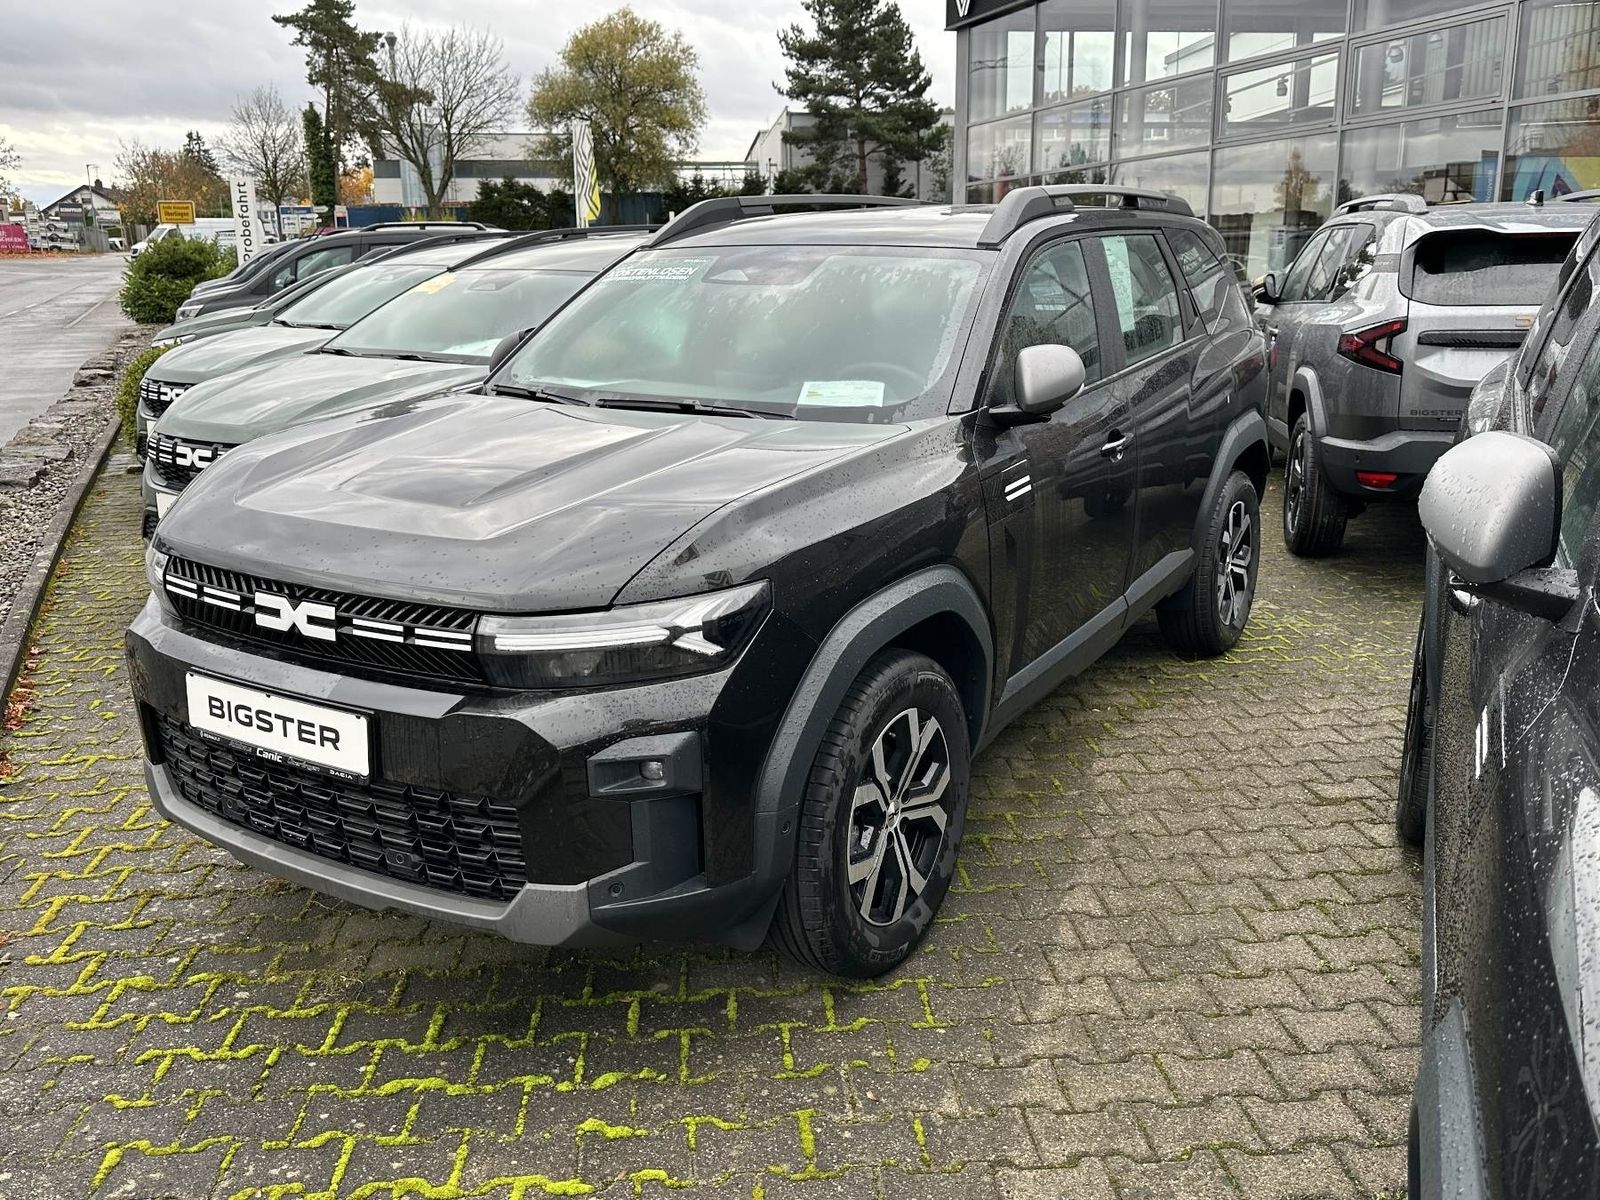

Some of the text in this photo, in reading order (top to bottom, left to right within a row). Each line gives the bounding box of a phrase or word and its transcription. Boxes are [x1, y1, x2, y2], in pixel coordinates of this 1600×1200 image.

[1410, 409, 1463, 417] BIGSTER
[207, 694, 341, 752] BIGSTER
[256, 747, 283, 763] Canic
